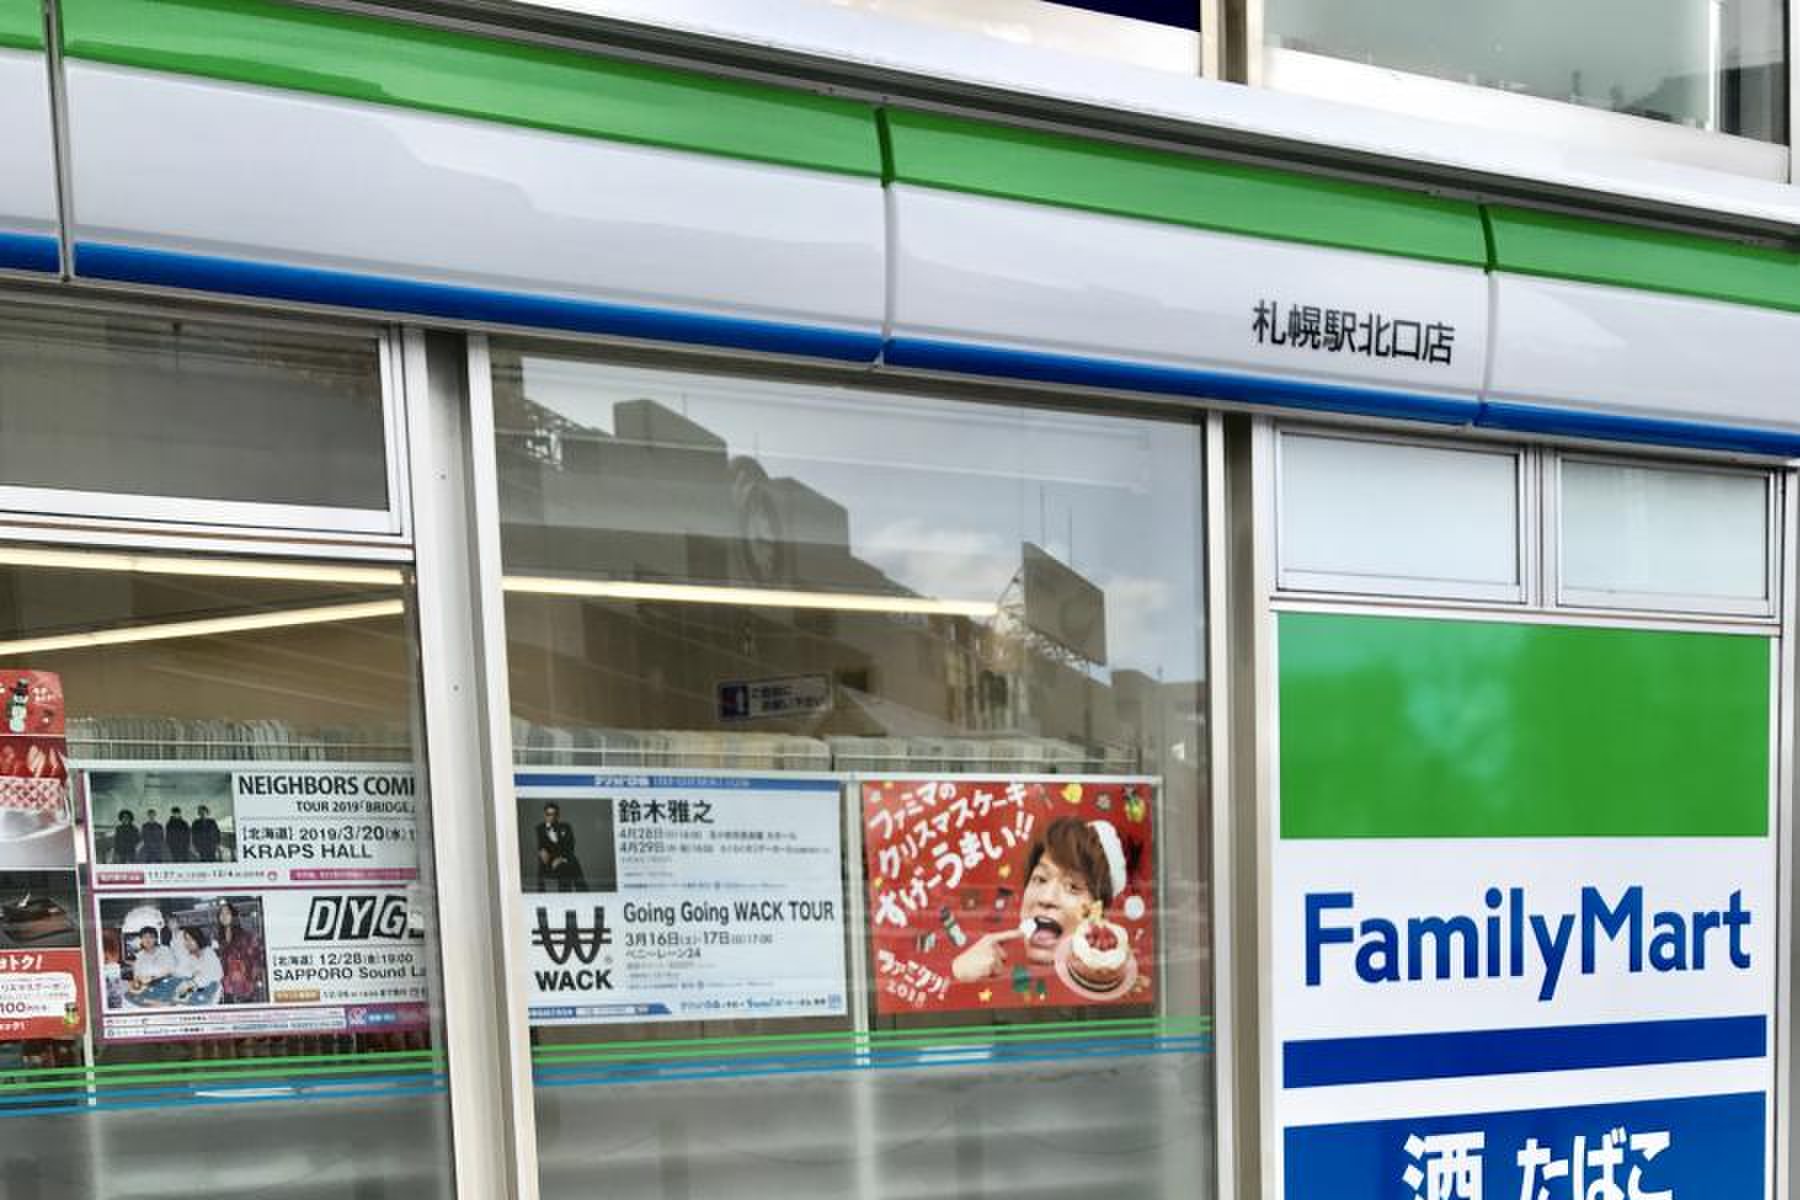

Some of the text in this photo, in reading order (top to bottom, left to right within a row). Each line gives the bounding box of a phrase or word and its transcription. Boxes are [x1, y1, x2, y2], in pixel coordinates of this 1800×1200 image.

[1252, 299, 1455, 365] 札幌駅北口店
[239, 775, 359, 795] NEIGHBORS
[296, 801, 329, 813] TOUR
[618, 799, 714, 824] 鈴木雅之
[868, 782, 956, 839] ファミマの
[880, 782, 1027, 879] クリスマスケーキ
[242, 843, 372, 860] KRAPS HALL
[623, 900, 835, 926] Going Going WACK TOUR
[1305, 886, 1752, 1001] FamilyMart
[273, 967, 353, 982] SAPPORO
[359, 966, 406, 981] Sound
[534, 969, 614, 992] WACK
